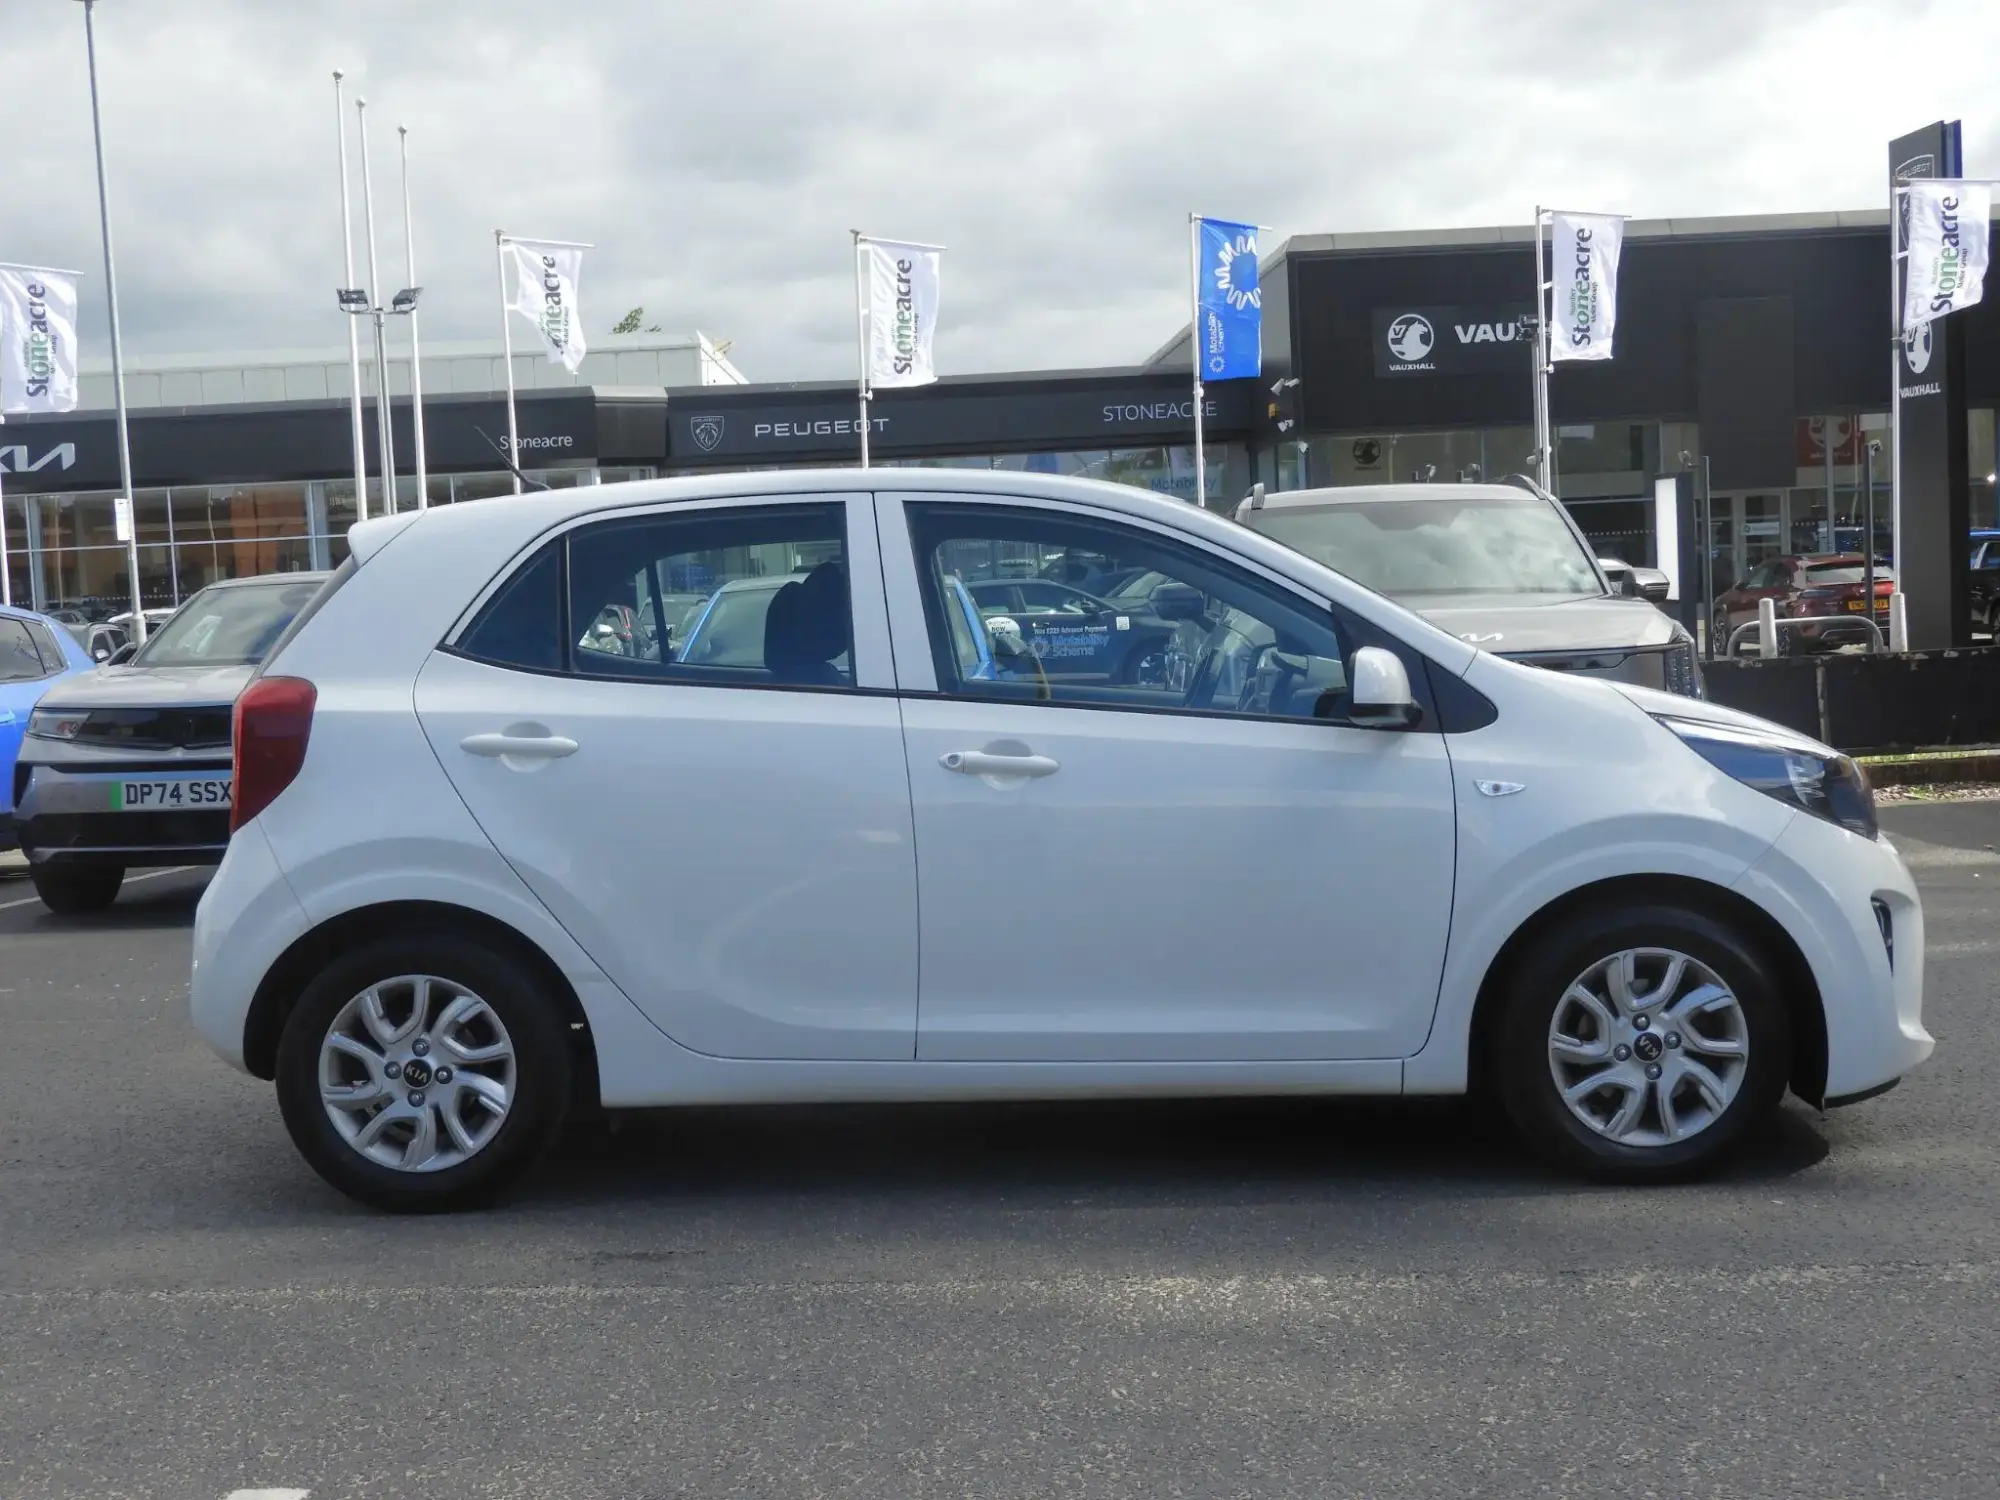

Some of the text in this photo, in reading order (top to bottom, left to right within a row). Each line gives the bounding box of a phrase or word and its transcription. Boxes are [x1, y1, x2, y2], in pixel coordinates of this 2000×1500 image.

[1930, 196, 1959, 313] Stoneacre
[1572, 228, 1592, 346] Stoneacre
[893, 259, 912, 375] Stoneacre
[26, 284, 50, 397] Stoneacre
[1389, 363, 1436, 371] VAUXHALL
[1899, 382, 1941, 398] VAUXHALL
[499, 435, 573, 450] Soneacre
[125, 781, 232, 805] DP74 SSX
[406, 1064, 428, 1083] KIA
